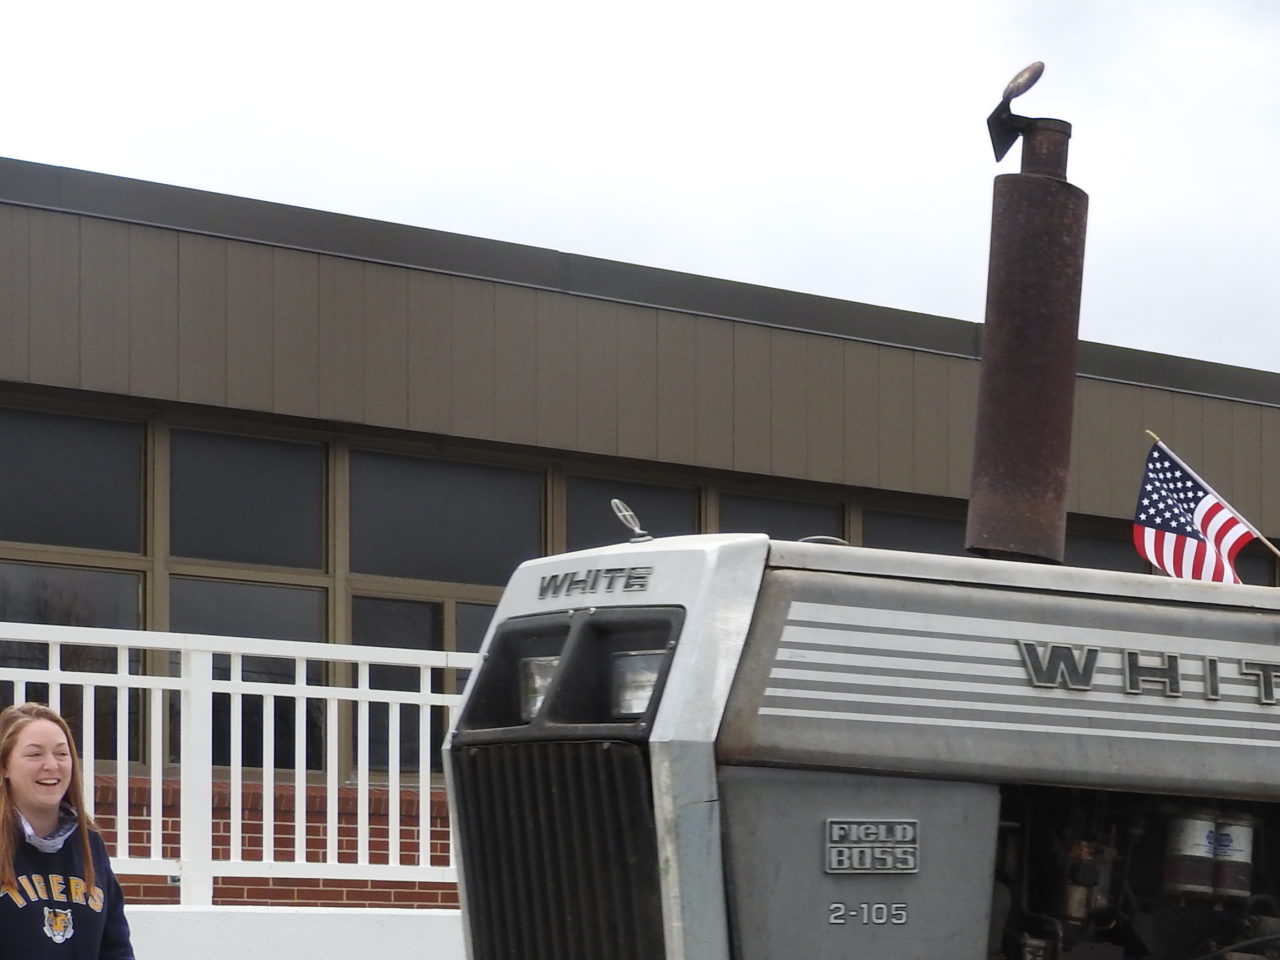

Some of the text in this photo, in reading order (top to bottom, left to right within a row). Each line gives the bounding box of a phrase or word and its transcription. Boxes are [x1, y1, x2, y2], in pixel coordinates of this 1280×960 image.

[538, 566, 654, 600] WHITE
[830, 847, 915, 869] BOSS
[0, 873, 105, 913] TIGERS
[829, 903, 907, 924] 2-105
